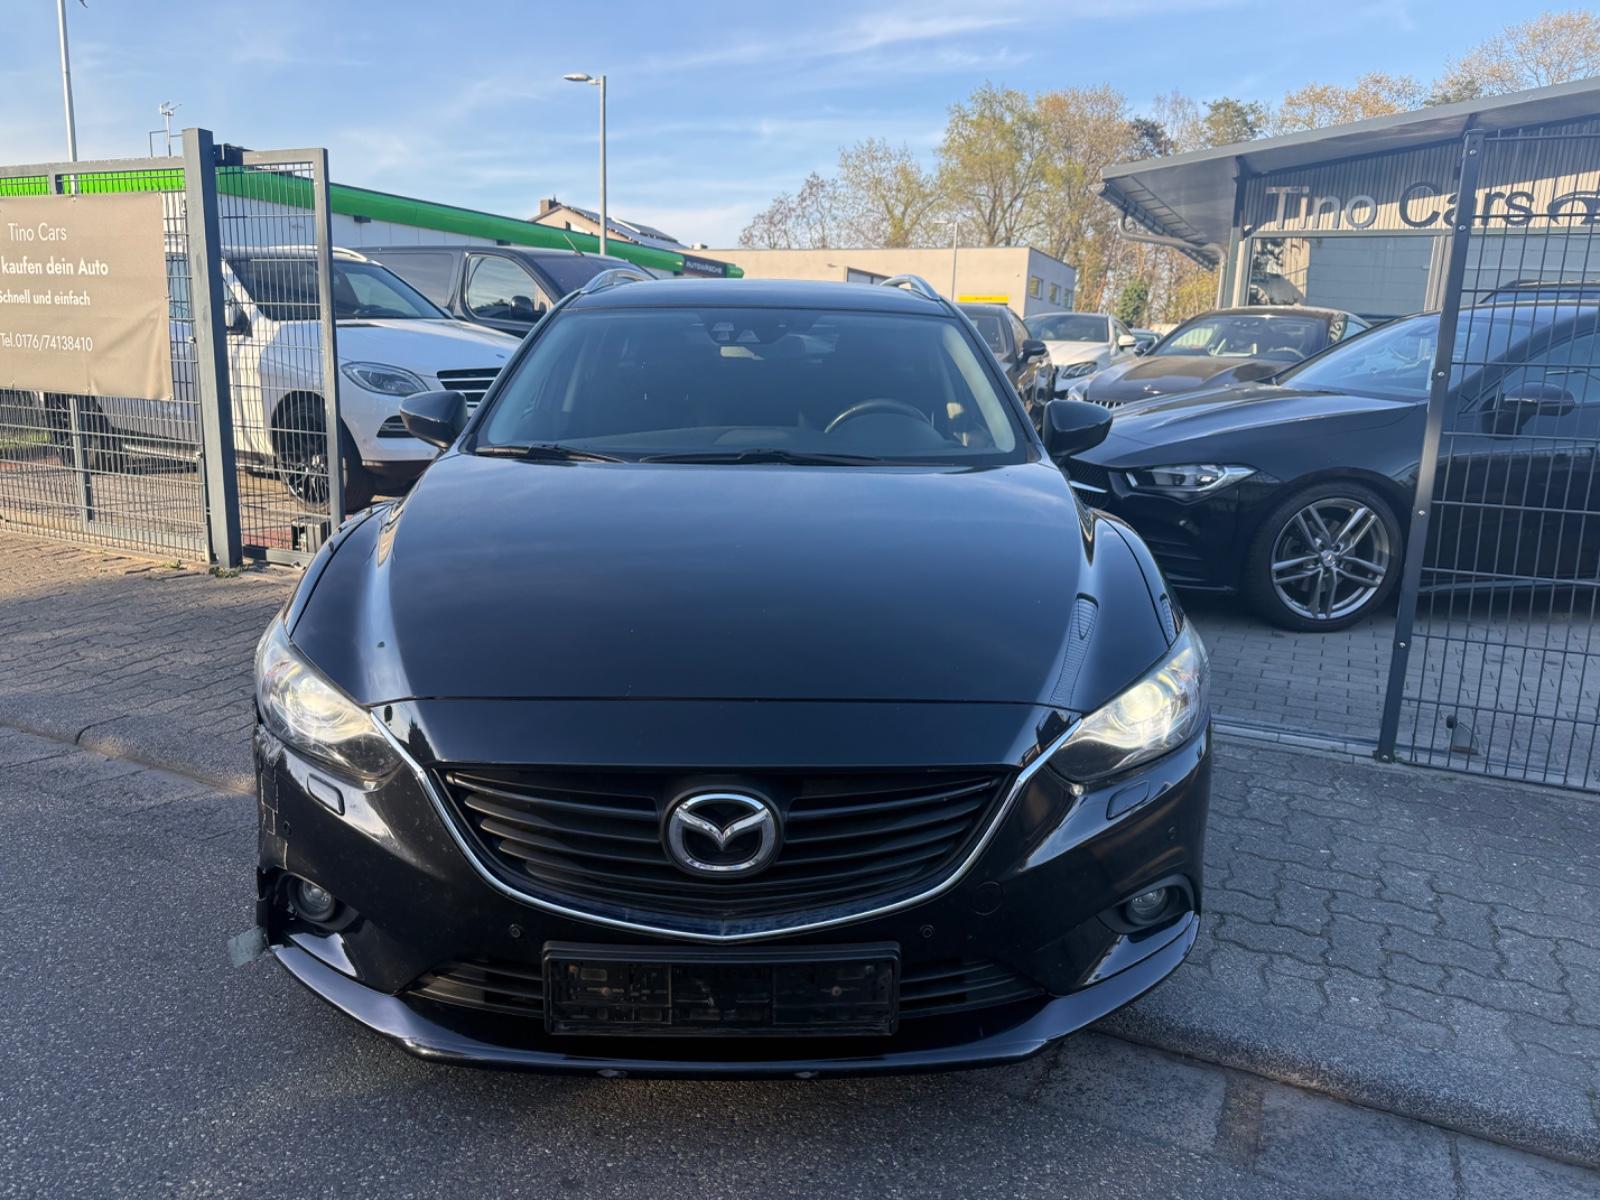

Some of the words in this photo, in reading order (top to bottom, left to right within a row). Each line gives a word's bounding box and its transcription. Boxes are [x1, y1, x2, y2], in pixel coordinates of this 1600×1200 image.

[1265, 186, 1378, 230] Tino
[7, 222, 34, 241] Tino
[38, 222, 67, 241] Cars
[0, 255, 42, 275] kaufen
[46, 255, 74, 275] dein
[78, 257, 109, 276] Auto
[33, 289, 52, 304] und
[54, 290, 91, 305] einfach
[0, 331, 93, 351] Tel.0176/74138410
